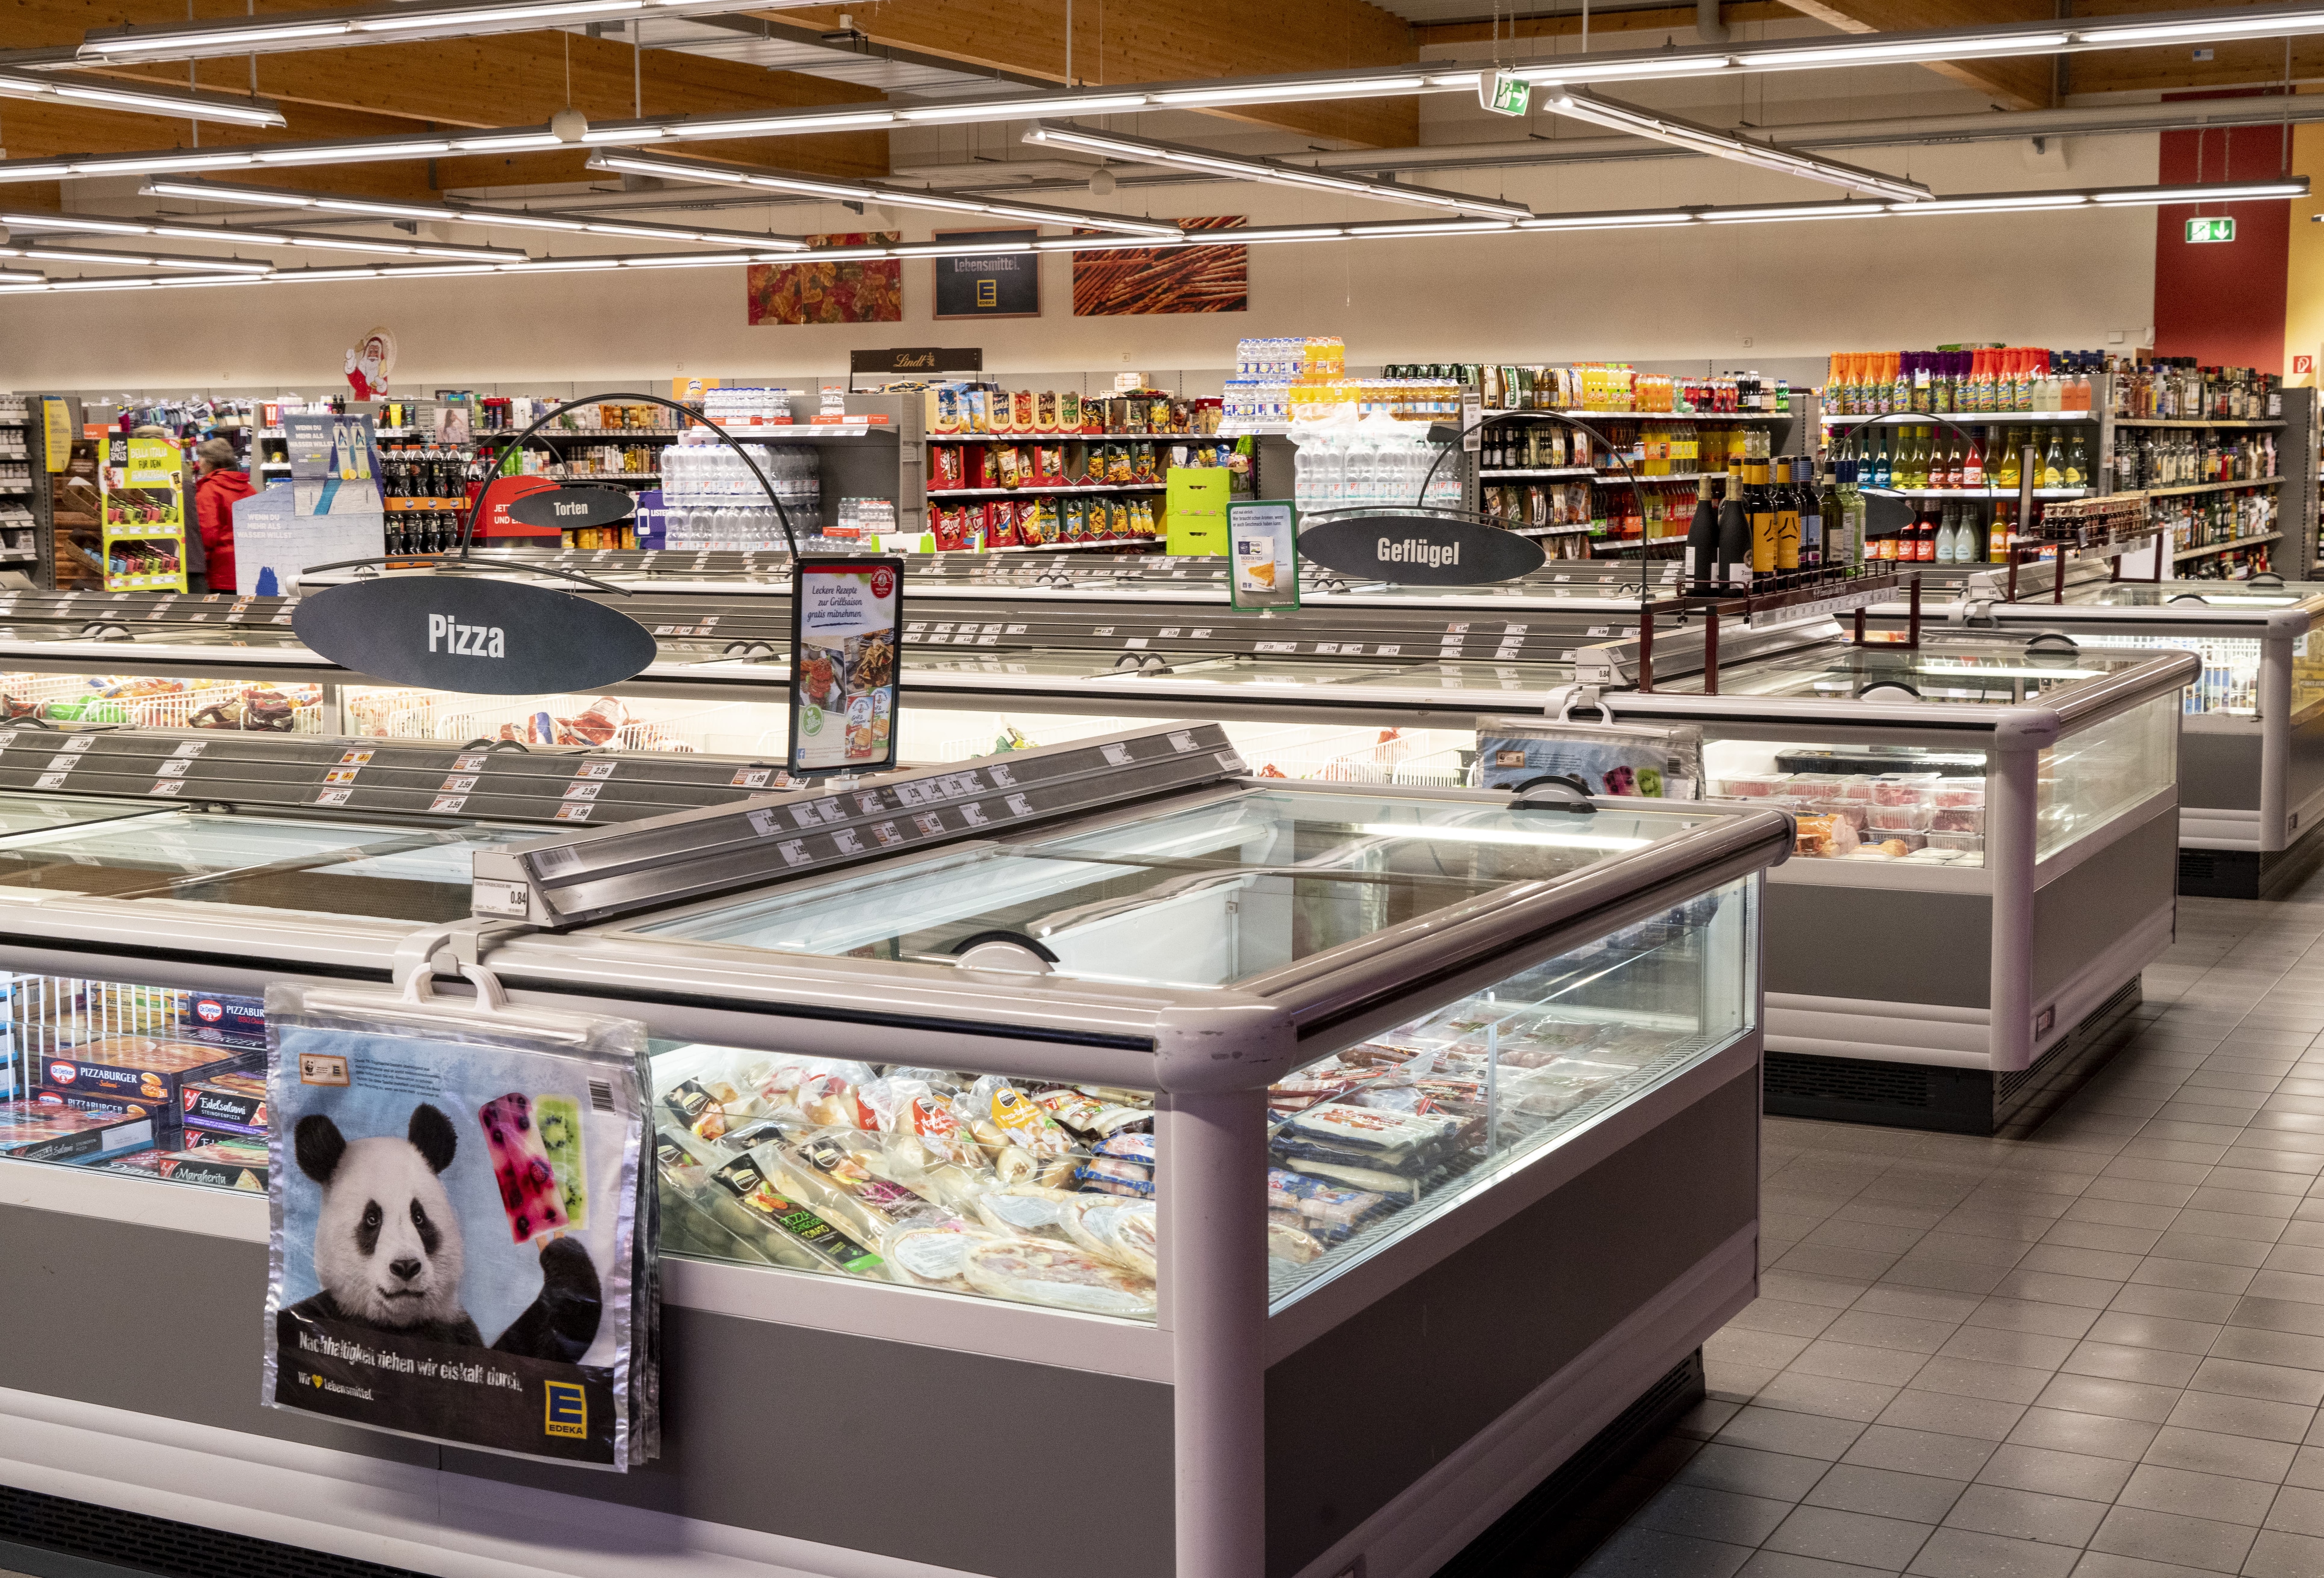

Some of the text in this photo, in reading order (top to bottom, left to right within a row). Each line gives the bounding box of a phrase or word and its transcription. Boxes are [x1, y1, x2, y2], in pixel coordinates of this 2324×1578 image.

[955, 256, 1020, 272] Lebensmittel.
[893, 353, 927, 368] Lindt
[110, 440, 125, 452] JUST
[168, 440, 179, 449] NEU
[130, 447, 168, 460] BELLA ITALIA
[553, 501, 589, 516] Torten
[1377, 537, 1459, 568] Geflügel
[812, 585, 858, 597] Leckere Rezepte
[830, 597, 863, 606] Grillsaison
[807, 609, 862, 622] gratis mitnehmen
[429, 613, 505, 658] Pizza
[510, 890, 527, 905] 0.84
[80, 1067, 138, 1084] PIZZABURGER
[199, 1097, 246, 1115] Edelsalami
[201, 1109, 241, 1121] STEINOFENPIZZA
[175, 1168, 227, 1184] Margherita
[779, 1210, 811, 1227] PIZZA
[801, 1224, 830, 1238] TOMATO
[299, 1331, 523, 1392] Nachhaltigkeit ziehen wir eiskalt durch.
[297, 1371, 374, 1401] Wir Lebensmittel.
[548, 1424, 584, 1435] EDEKA
